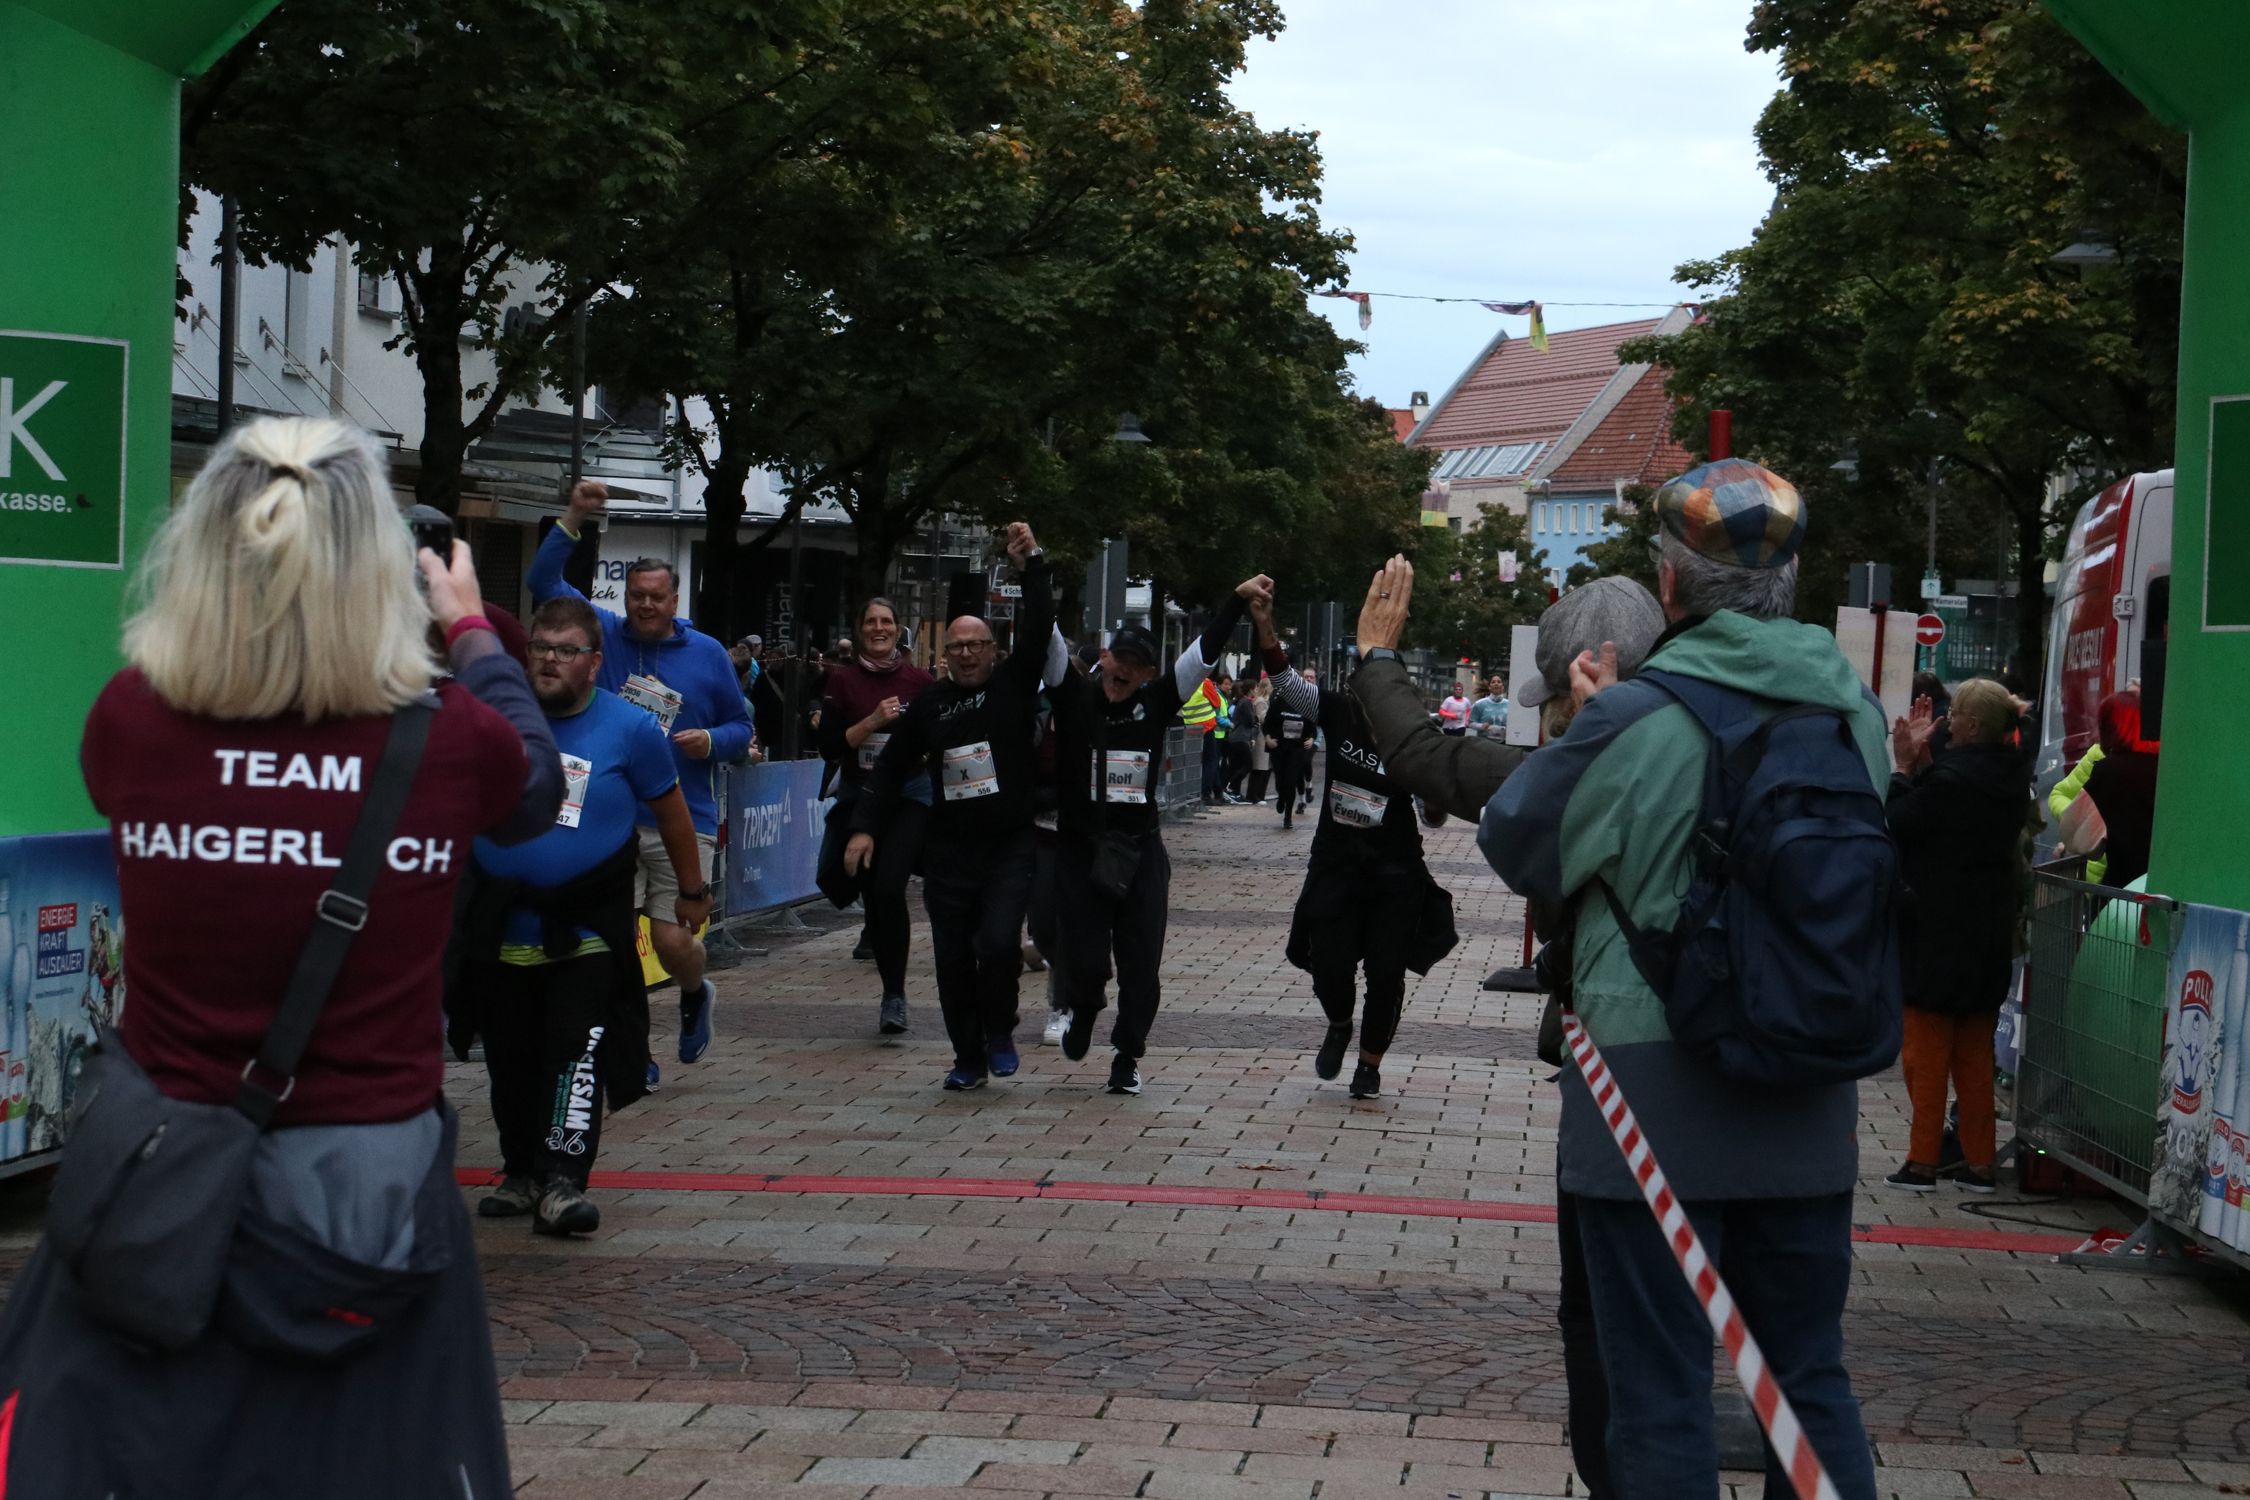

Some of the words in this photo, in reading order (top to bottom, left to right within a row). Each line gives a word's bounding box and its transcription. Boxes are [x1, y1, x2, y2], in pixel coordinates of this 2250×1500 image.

[214, 749, 362, 792] TEAM
[1108, 773, 1132, 784] Rolf
[1334, 802, 1371, 823] Evelyn
[120, 821, 453, 874] HAIGERLCH
[40, 906, 75, 929] ENERGIE
[40, 931, 66, 952] KRAFT
